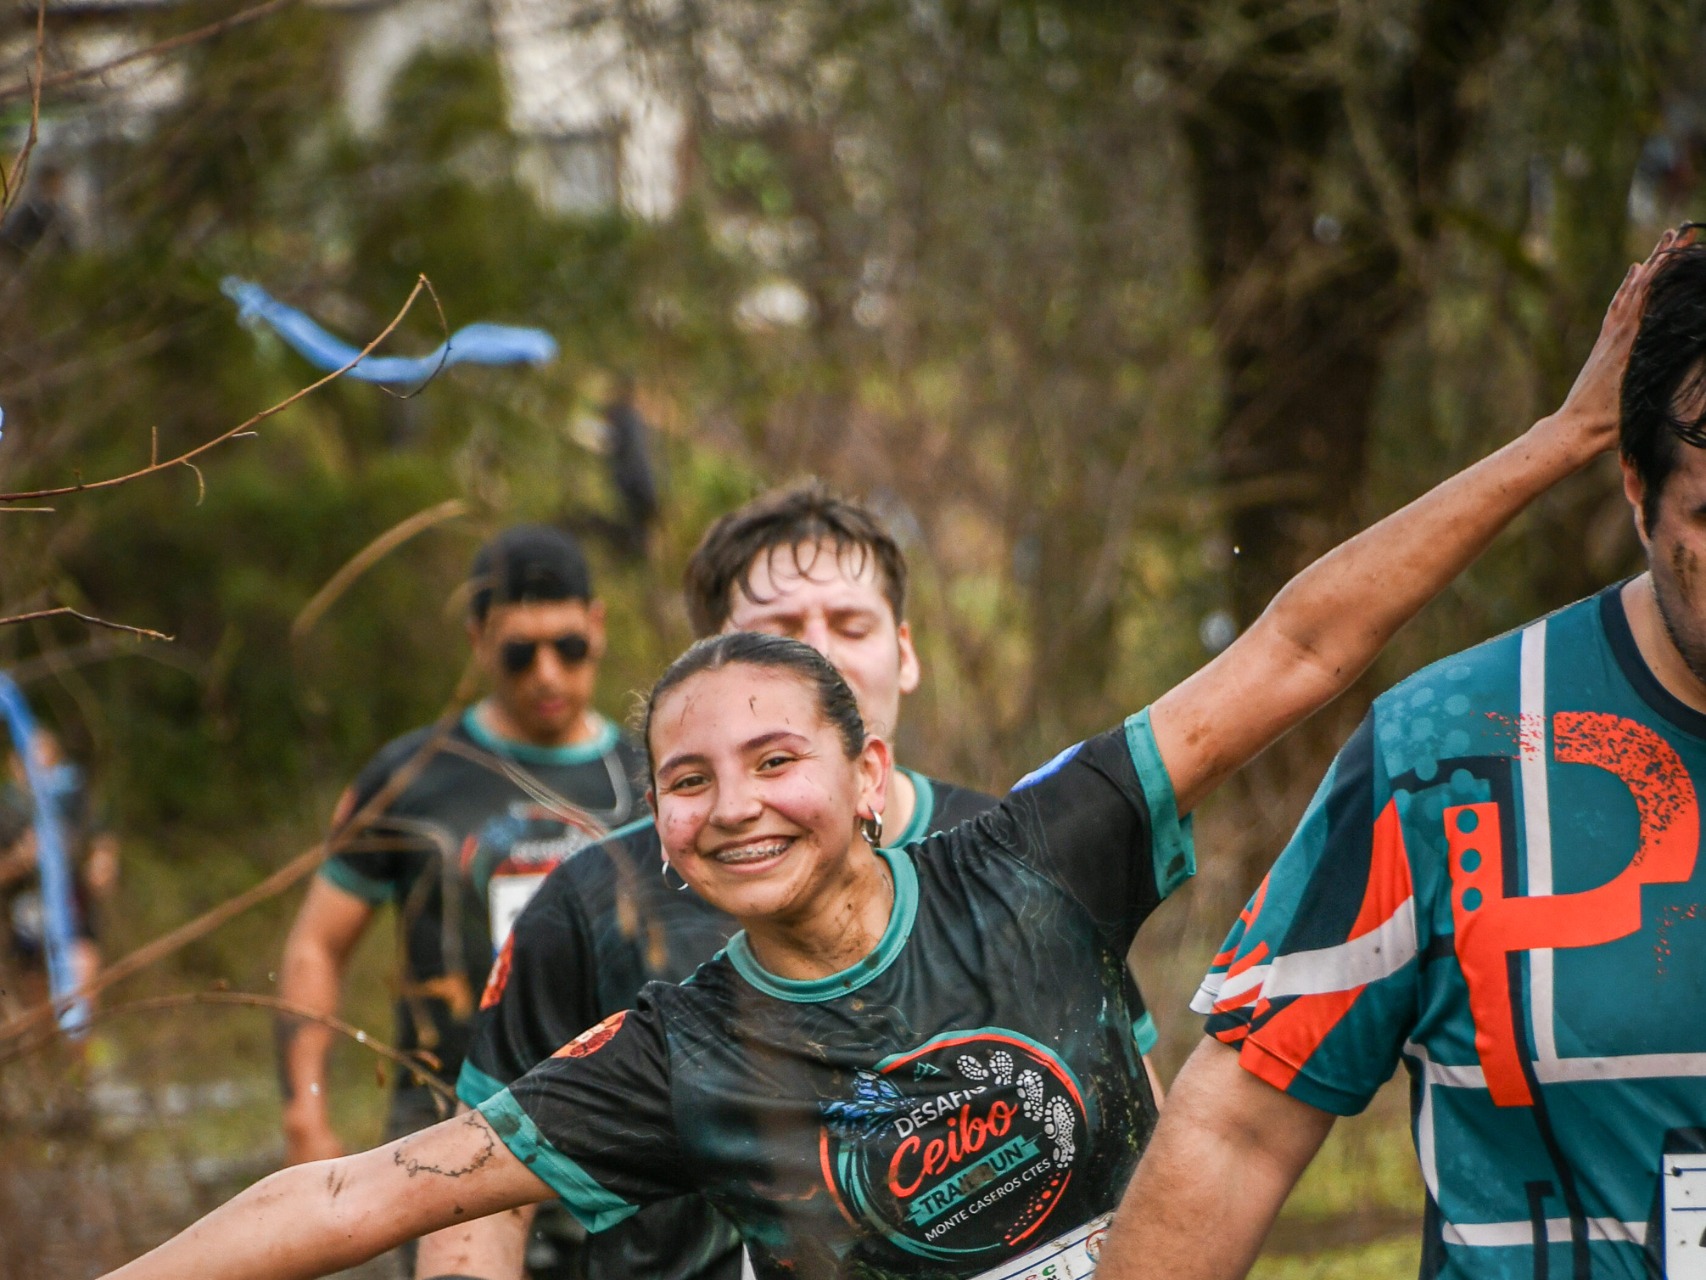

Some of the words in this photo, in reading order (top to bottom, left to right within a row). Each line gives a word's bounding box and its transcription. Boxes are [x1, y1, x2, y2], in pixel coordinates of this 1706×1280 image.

[888, 1100, 1018, 1198] Ceibo
[919, 1172, 974, 1215] TRA
[979, 1142, 1025, 1180] UN
[924, 1208, 969, 1242] MONTE
[968, 1177, 1022, 1215] CASEROS
[1021, 1157, 1051, 1182] CTES
